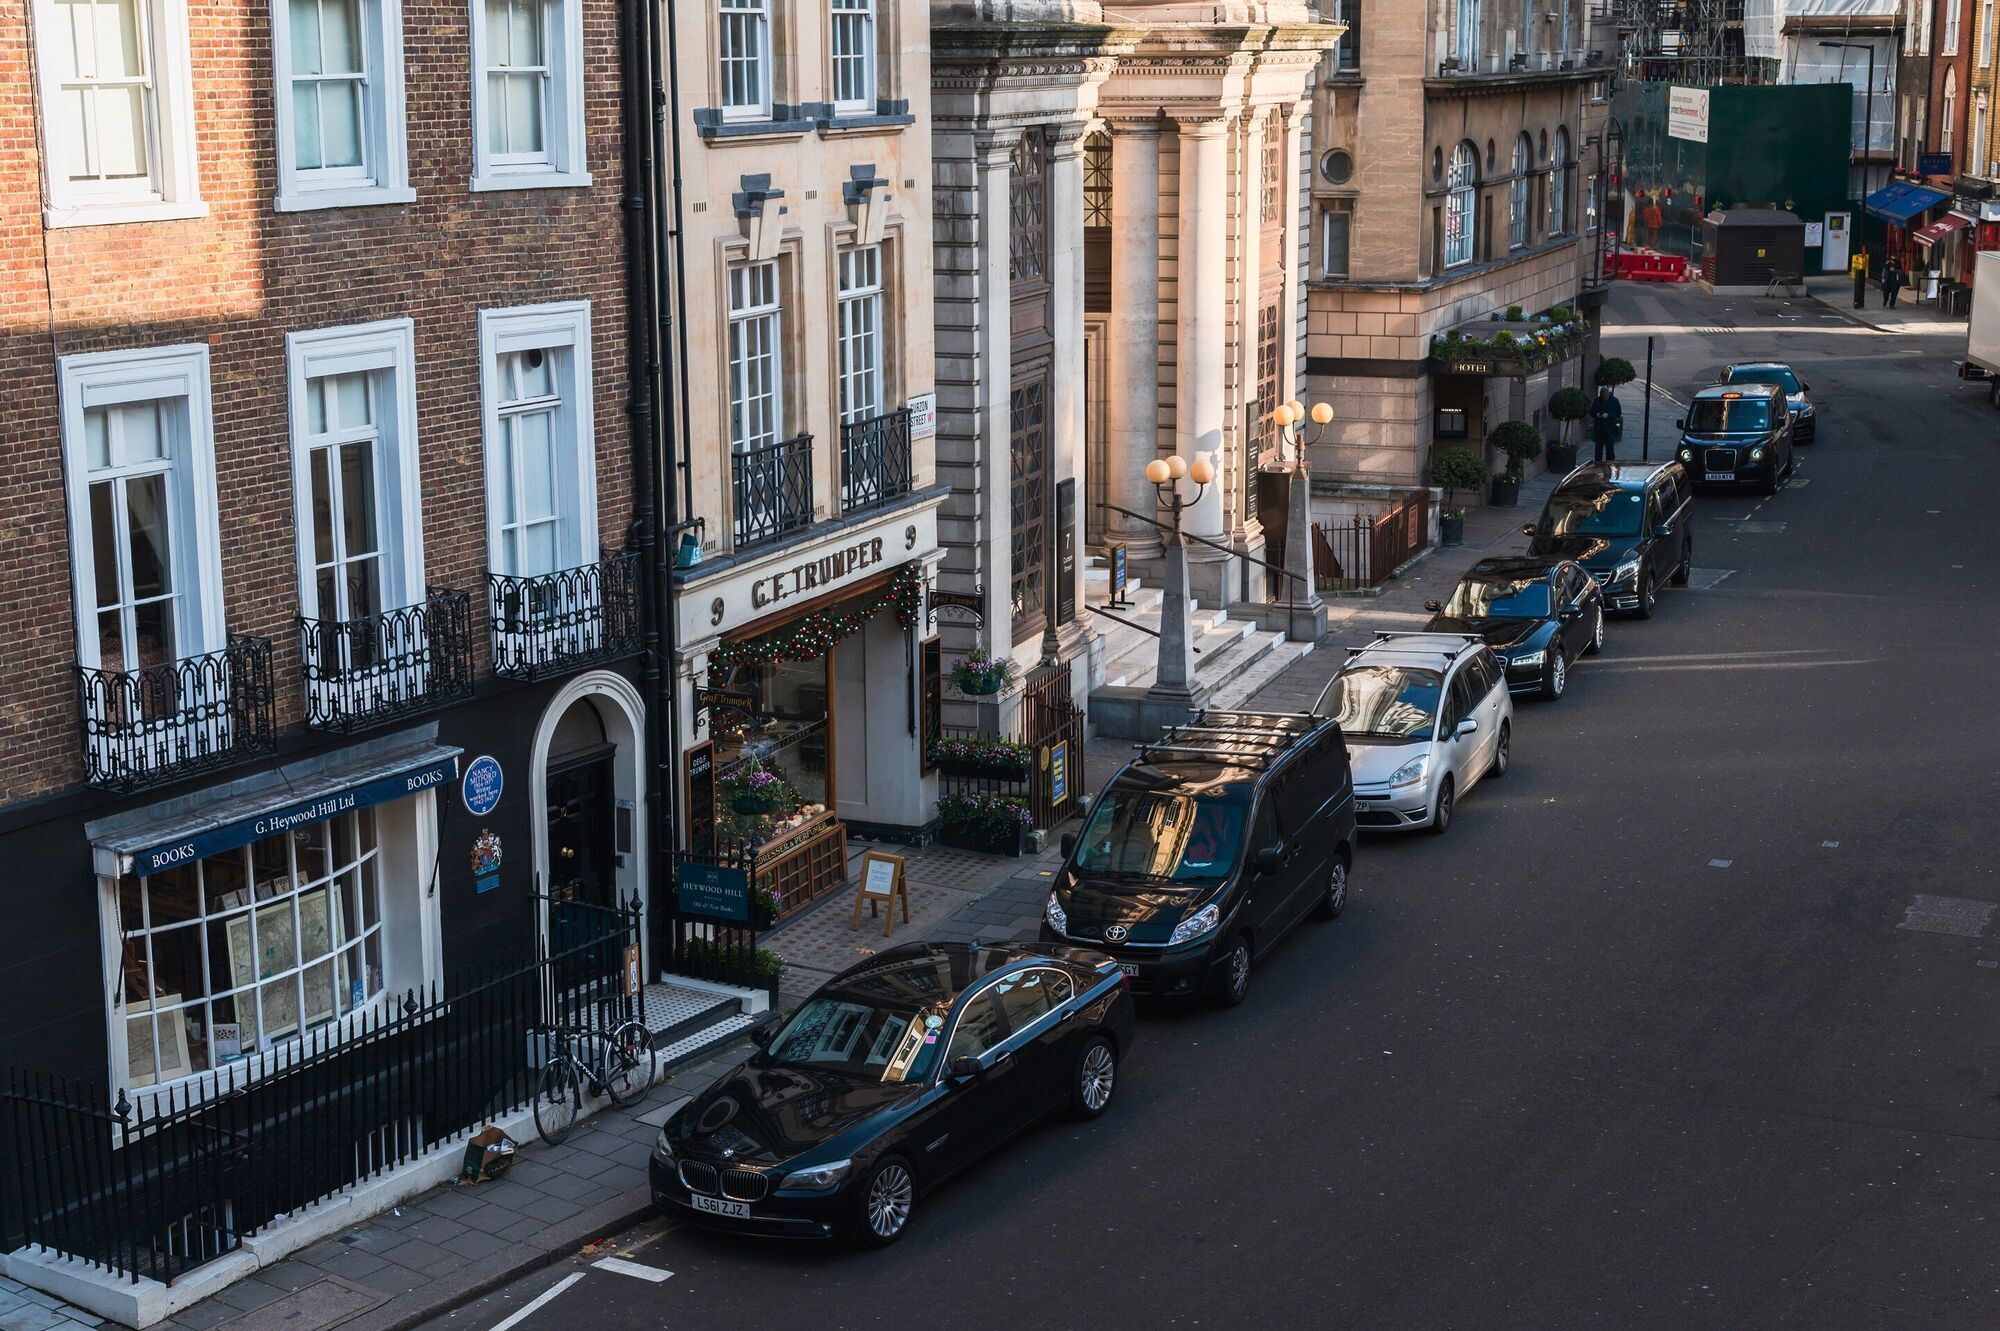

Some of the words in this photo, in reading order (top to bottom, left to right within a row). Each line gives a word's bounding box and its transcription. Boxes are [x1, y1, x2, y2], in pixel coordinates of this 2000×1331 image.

[1455, 364, 1489, 373] HOTEL
[911, 413, 926, 427] STREET
[927, 411, 934, 422] W1
[905, 525, 917, 550] 9
[1065, 532, 1071, 550] 7
[792, 536, 883, 594] TRUMPER
[711, 596, 724, 626] 9
[470, 770, 497, 785] MITFORD
[472, 765, 493, 777] NANCY
[690, 761, 710, 777] TRUMPER
[406, 768, 444, 791] BOOKS
[475, 785, 492, 794] Writer
[255, 821, 268, 835] G.
[269, 805, 317, 832] Heywood
[318, 798, 337, 817] Hill
[339, 793, 355, 810] Ltd
[794, 820, 828, 842] PERFUMER
[152, 843, 195, 869] BOOKS
[682, 882, 723, 894] HEYWOOD
[725, 887, 743, 897] HILL
[697, 1196, 720, 1213] LS61
[722, 1202, 744, 1216] ZJZ
